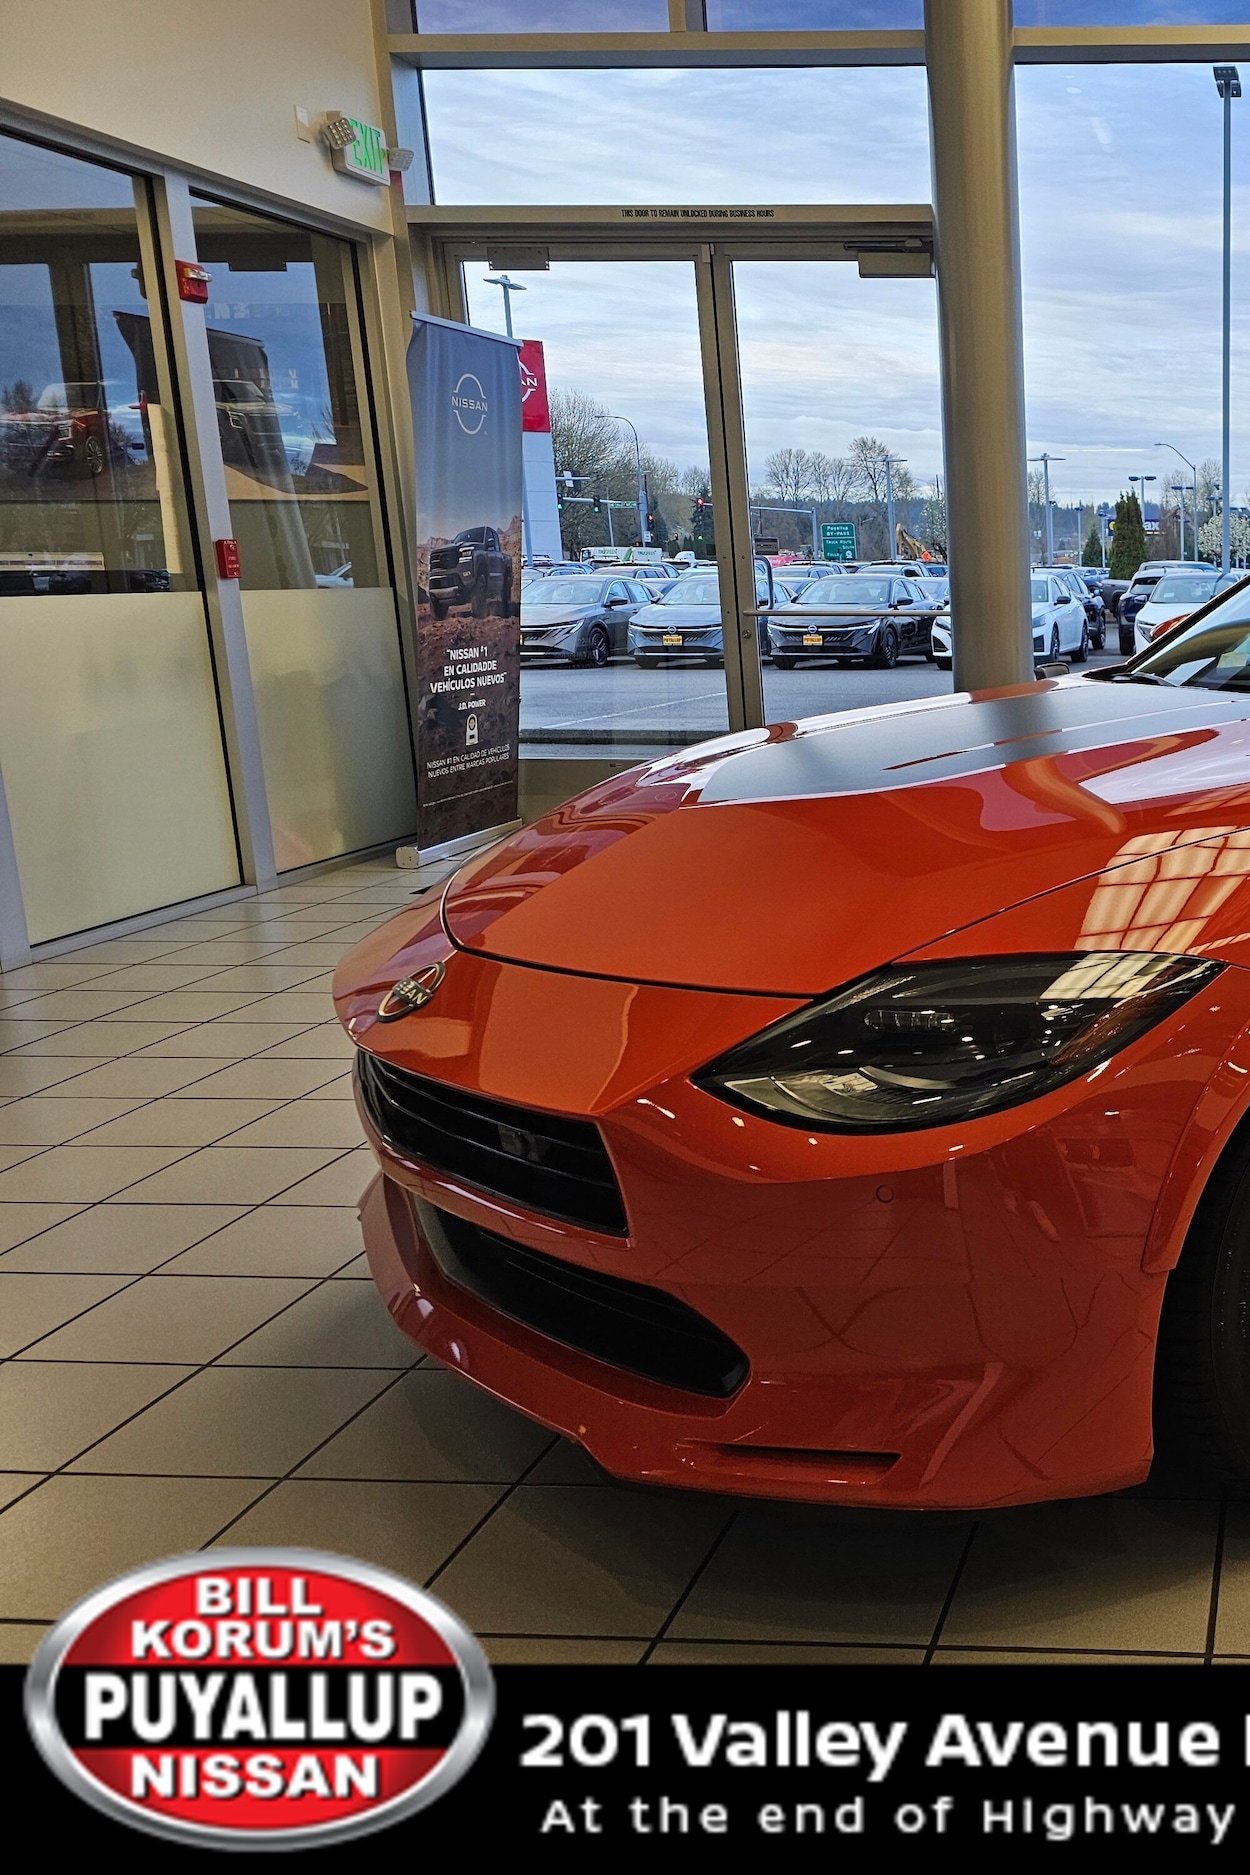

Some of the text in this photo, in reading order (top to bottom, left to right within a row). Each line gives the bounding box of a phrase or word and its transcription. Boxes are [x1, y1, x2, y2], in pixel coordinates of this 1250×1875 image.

[348, 118, 383, 174] EXIT
[621, 209, 775, 217] THIS DOOR TO REMAIN UNLOCKED DURING BUSINESS HOURS
[452, 397, 487, 411] NISSAN
[443, 665, 455, 676] EN
[430, 677, 475, 693] VEHÍCULOS
[467, 699, 486, 709] POWER
[426, 760, 446, 769] NISSAN
[453, 756, 460, 764] EN
[460, 750, 480, 762] CALIDAD
[481, 749, 487, 757] DE
[427, 752, 510, 778] NUEVOS ENTRE MARCAS POPULARES
